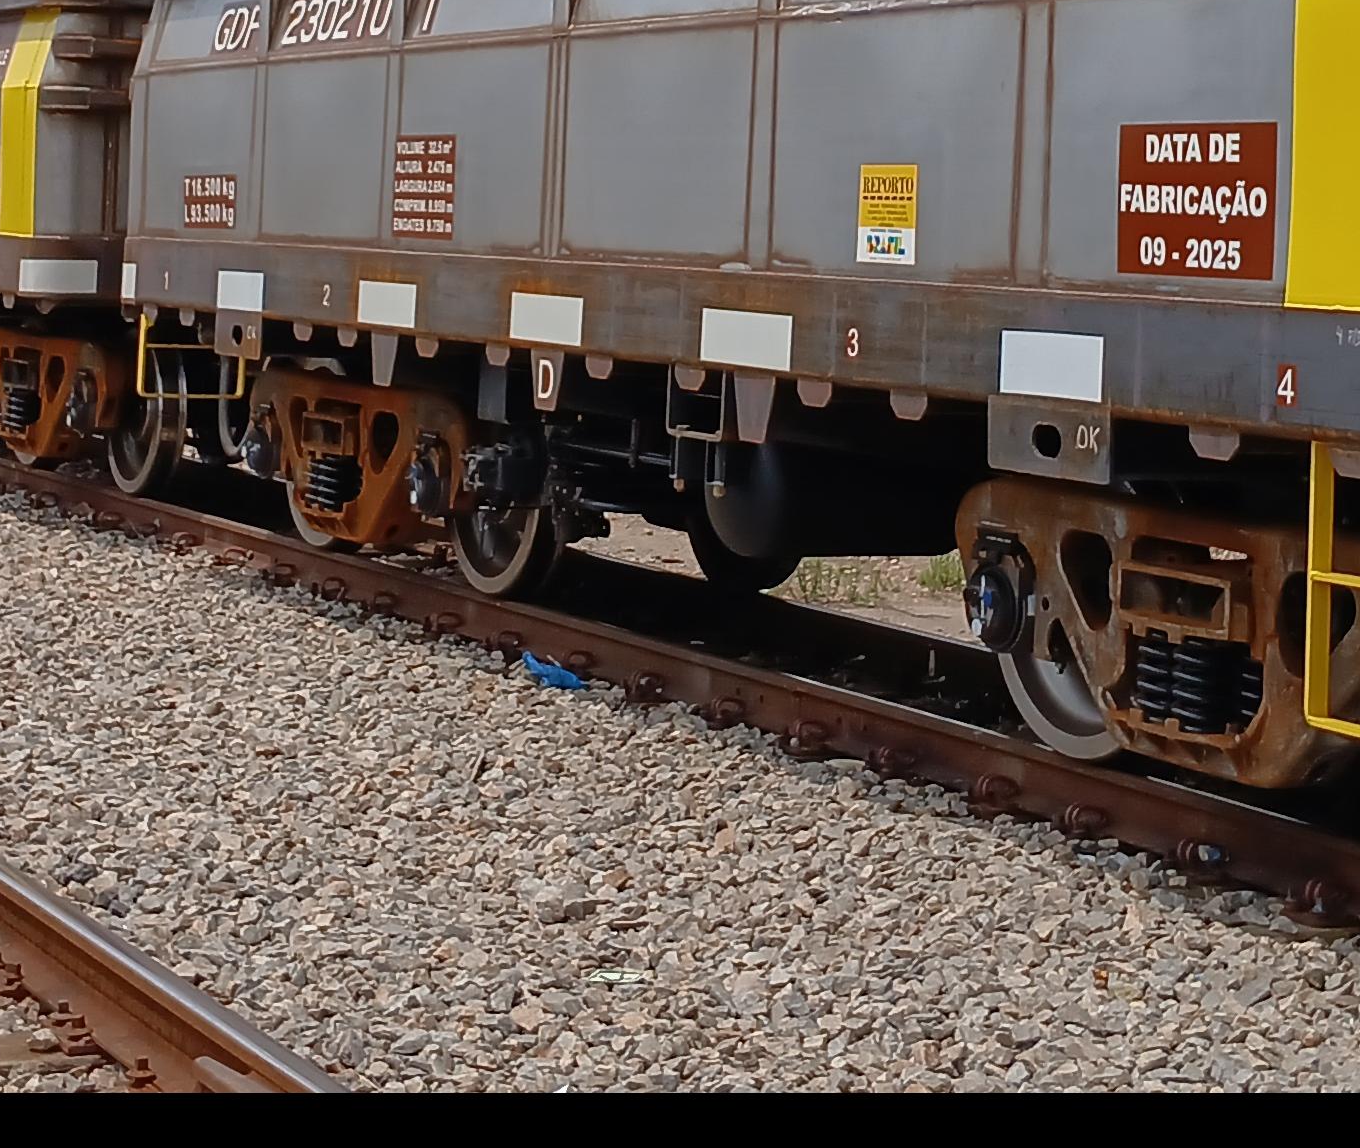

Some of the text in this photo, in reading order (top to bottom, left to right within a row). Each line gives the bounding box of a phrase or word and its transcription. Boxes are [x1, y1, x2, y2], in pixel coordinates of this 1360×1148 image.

[1145, 132, 1241, 163] DATA DE
[862, 176, 914, 194] REPORTO
[1120, 180, 1268, 224] FABRICAÇÃO
[1140, 236, 1166, 266] 09
[1185, 238, 1241, 271] 2025
[322, 283, 332, 307] 2
[846, 327, 859, 357] 3
[537, 358, 554, 399] D
[1277, 368, 1295, 405] 4
[1075, 424, 1101, 455] OK
